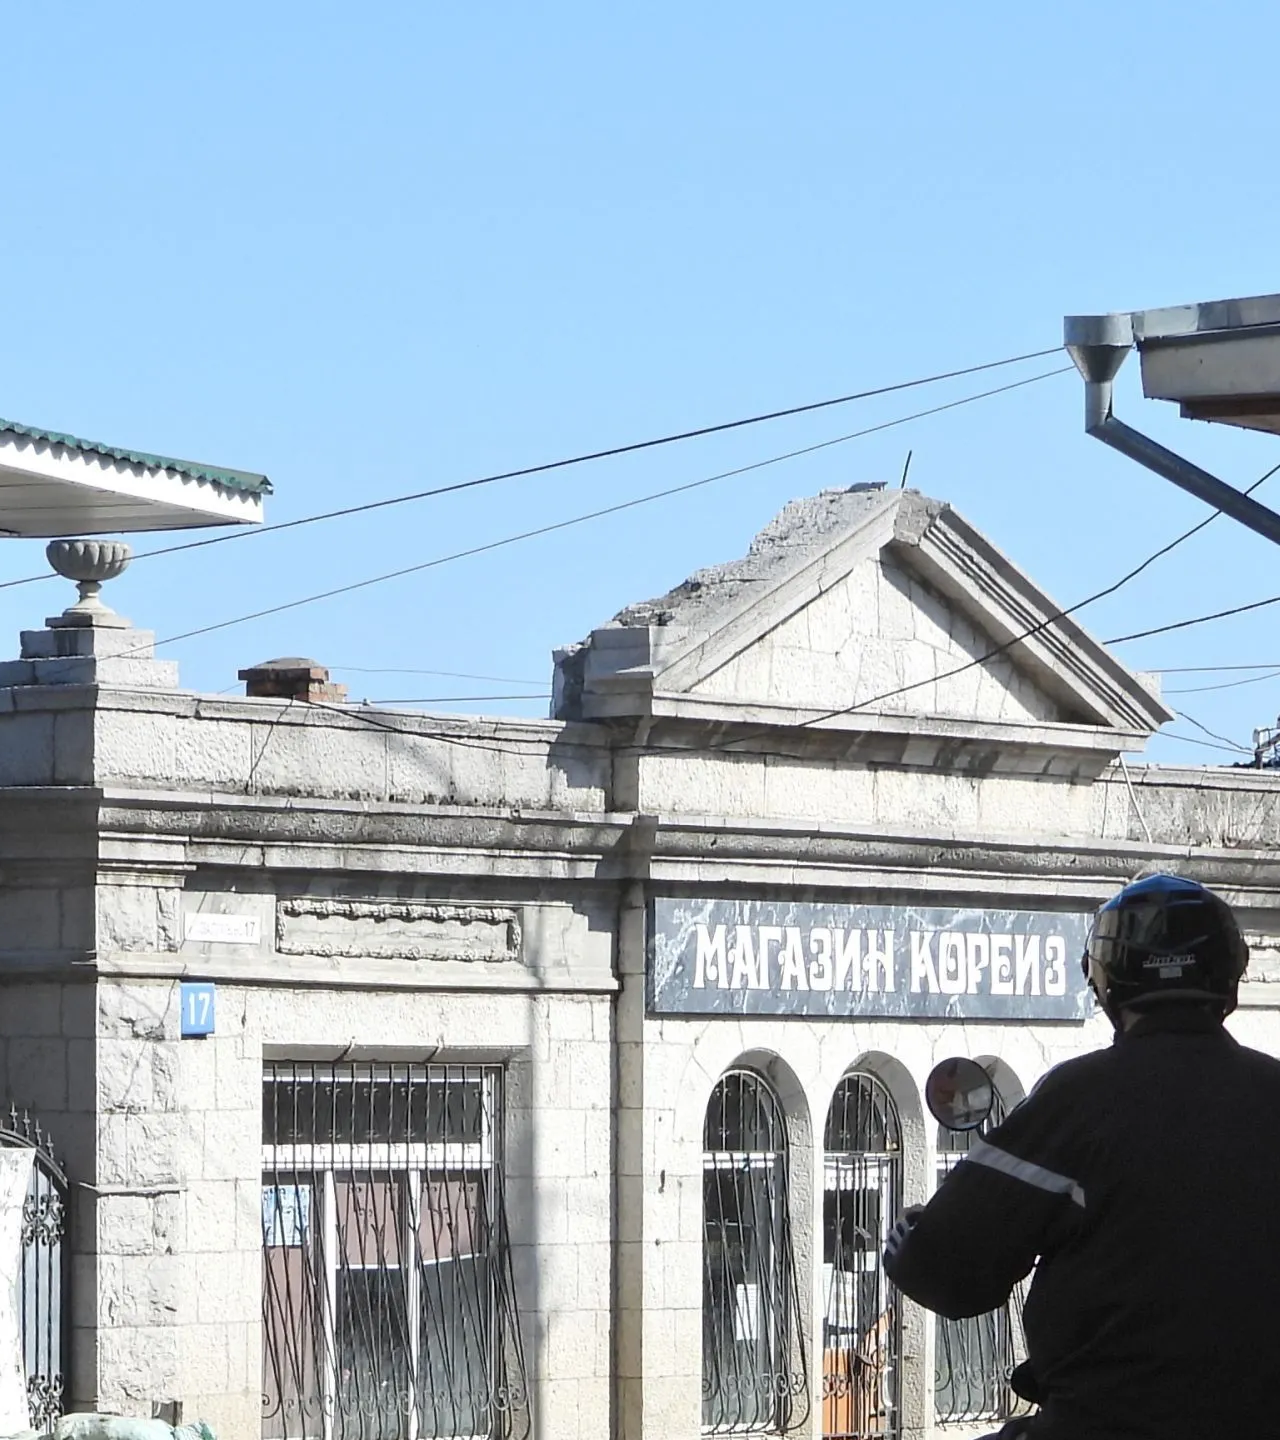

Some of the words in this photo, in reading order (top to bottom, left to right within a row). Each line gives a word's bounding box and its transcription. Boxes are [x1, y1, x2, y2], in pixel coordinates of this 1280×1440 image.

[244, 921, 256, 937] 17
[692, 923, 897, 993] МАГАЗИН
[910, 930, 1067, 997] КОРЕИЗ
[188, 992, 211, 1026] 17
